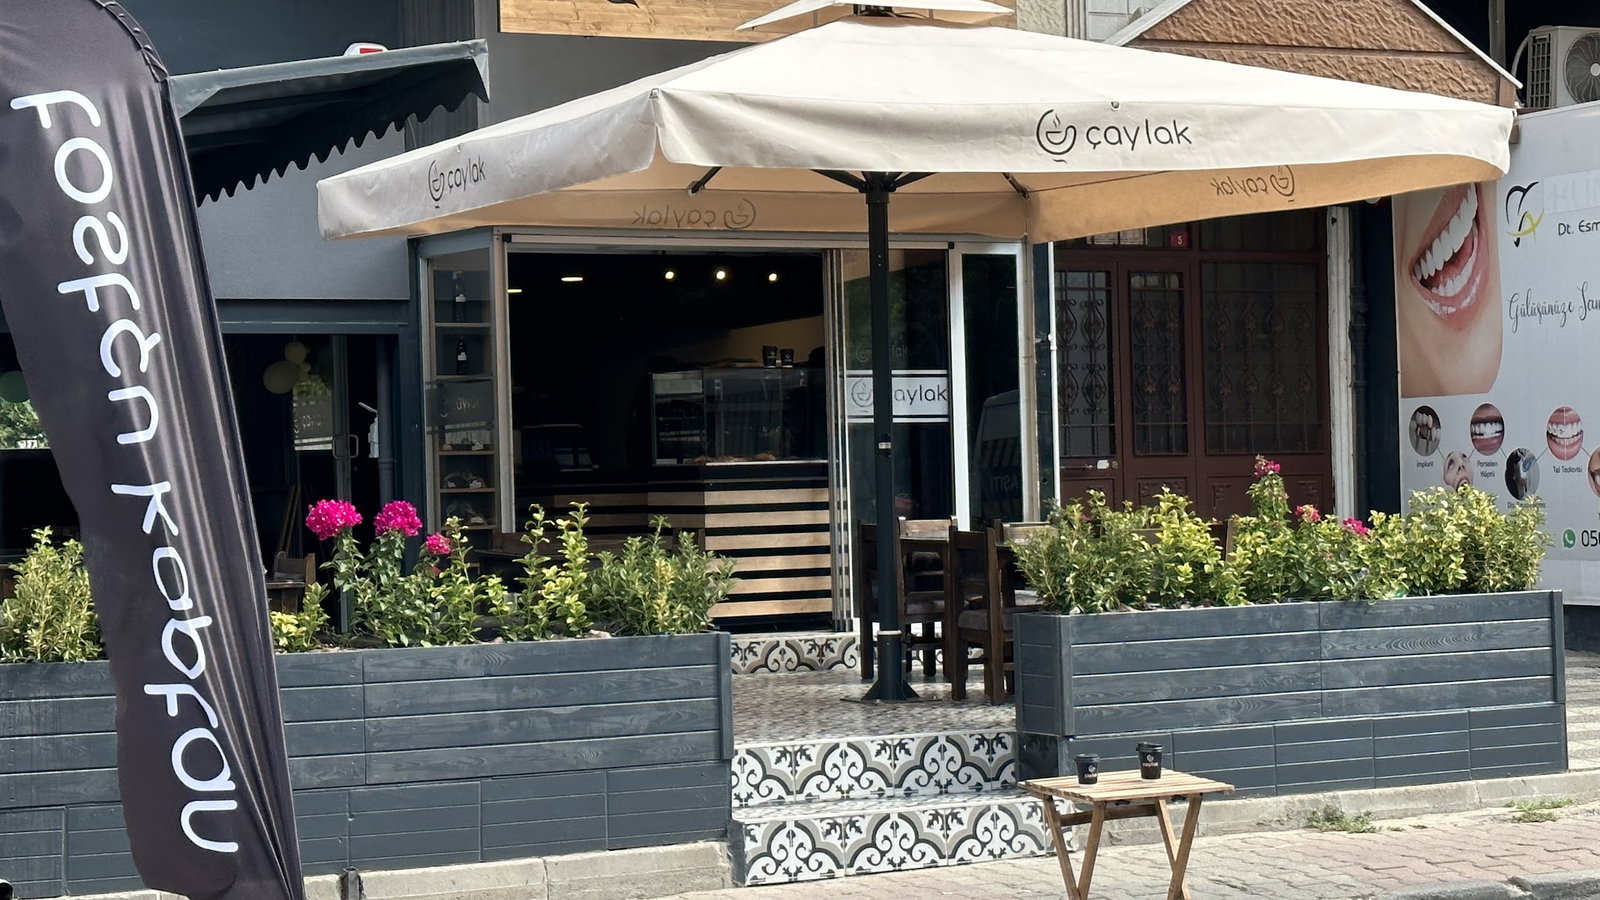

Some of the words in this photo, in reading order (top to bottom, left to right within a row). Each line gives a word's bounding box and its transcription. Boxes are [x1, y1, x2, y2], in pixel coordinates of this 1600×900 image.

[1085, 118, 1193, 152] çaylak
[447, 155, 486, 193] çaylak
[1557, 222, 1574, 236] Dt.
[1176, 235, 1184, 246] 5
[1507, 287, 1575, 334] Gülüşünüze
[893, 384, 948, 406] aylak
[1581, 529, 1600, 548] 05
